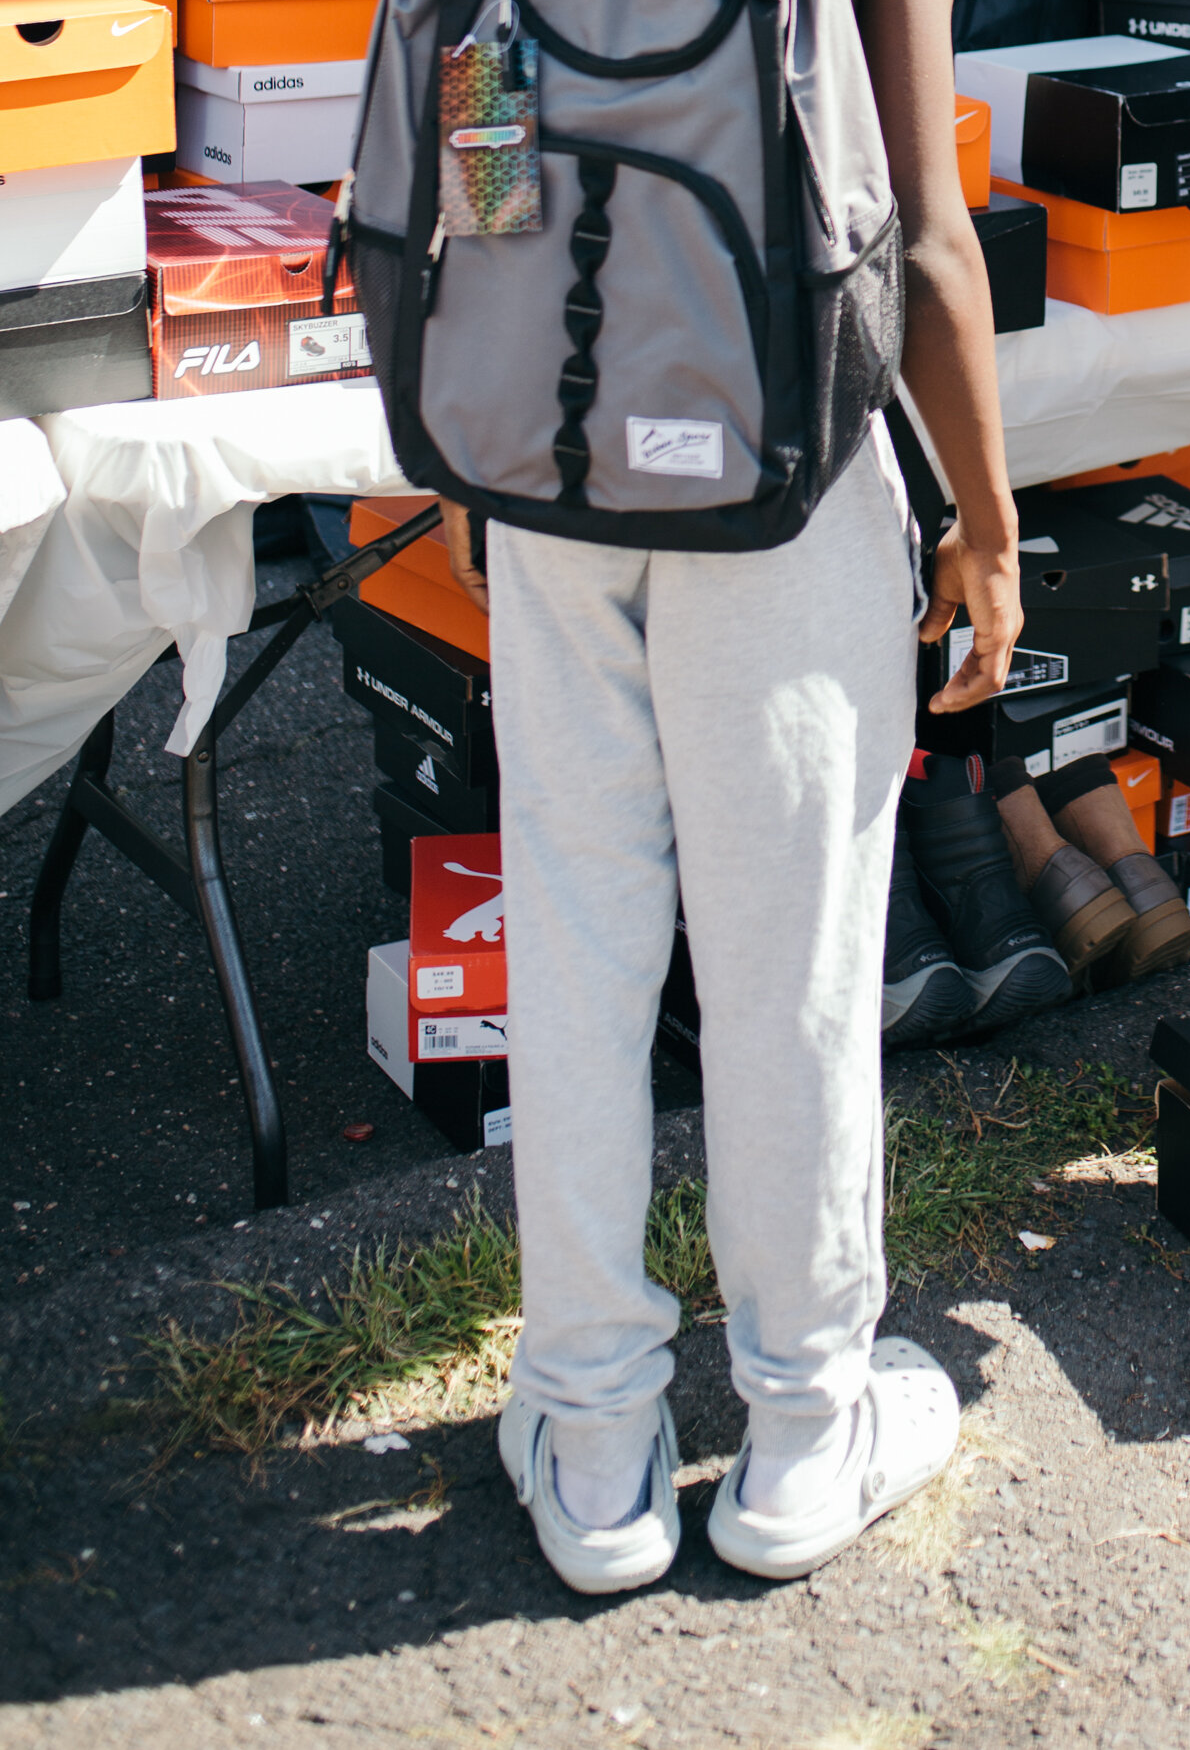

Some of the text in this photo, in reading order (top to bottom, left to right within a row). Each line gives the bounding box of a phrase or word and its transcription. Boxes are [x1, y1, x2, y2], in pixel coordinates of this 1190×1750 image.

[253, 75, 304, 91] adidas
[204, 145, 232, 165] adidas
[293, 320, 338, 331] SKYBUZZER
[333, 333, 349, 343] 3.5
[174, 340, 261, 379] FILA
[371, 676, 454, 747] UNDER ARMOUR
